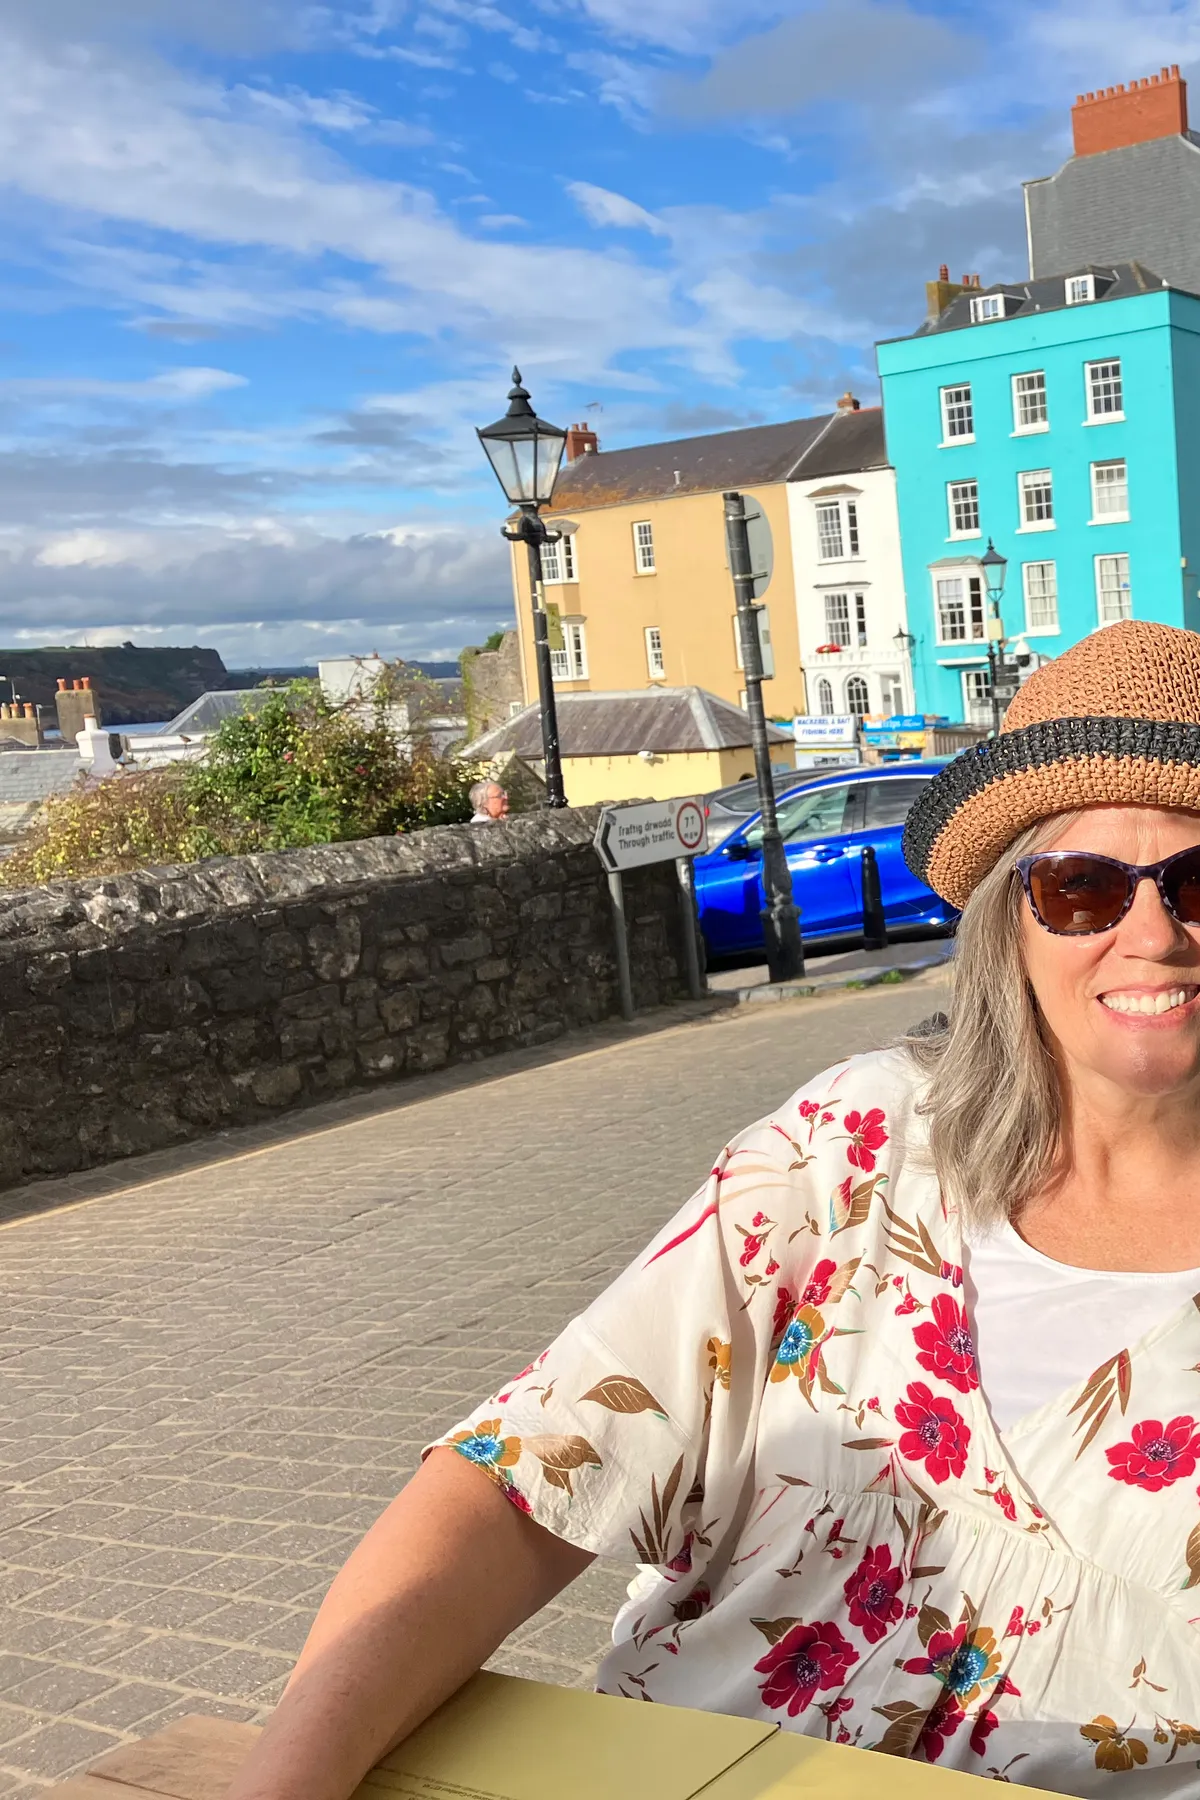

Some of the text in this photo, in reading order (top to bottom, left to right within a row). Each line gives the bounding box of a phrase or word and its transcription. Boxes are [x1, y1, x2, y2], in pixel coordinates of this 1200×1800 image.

[618, 824, 642, 836] Traffig
[618, 830, 675, 850] Through traffic
